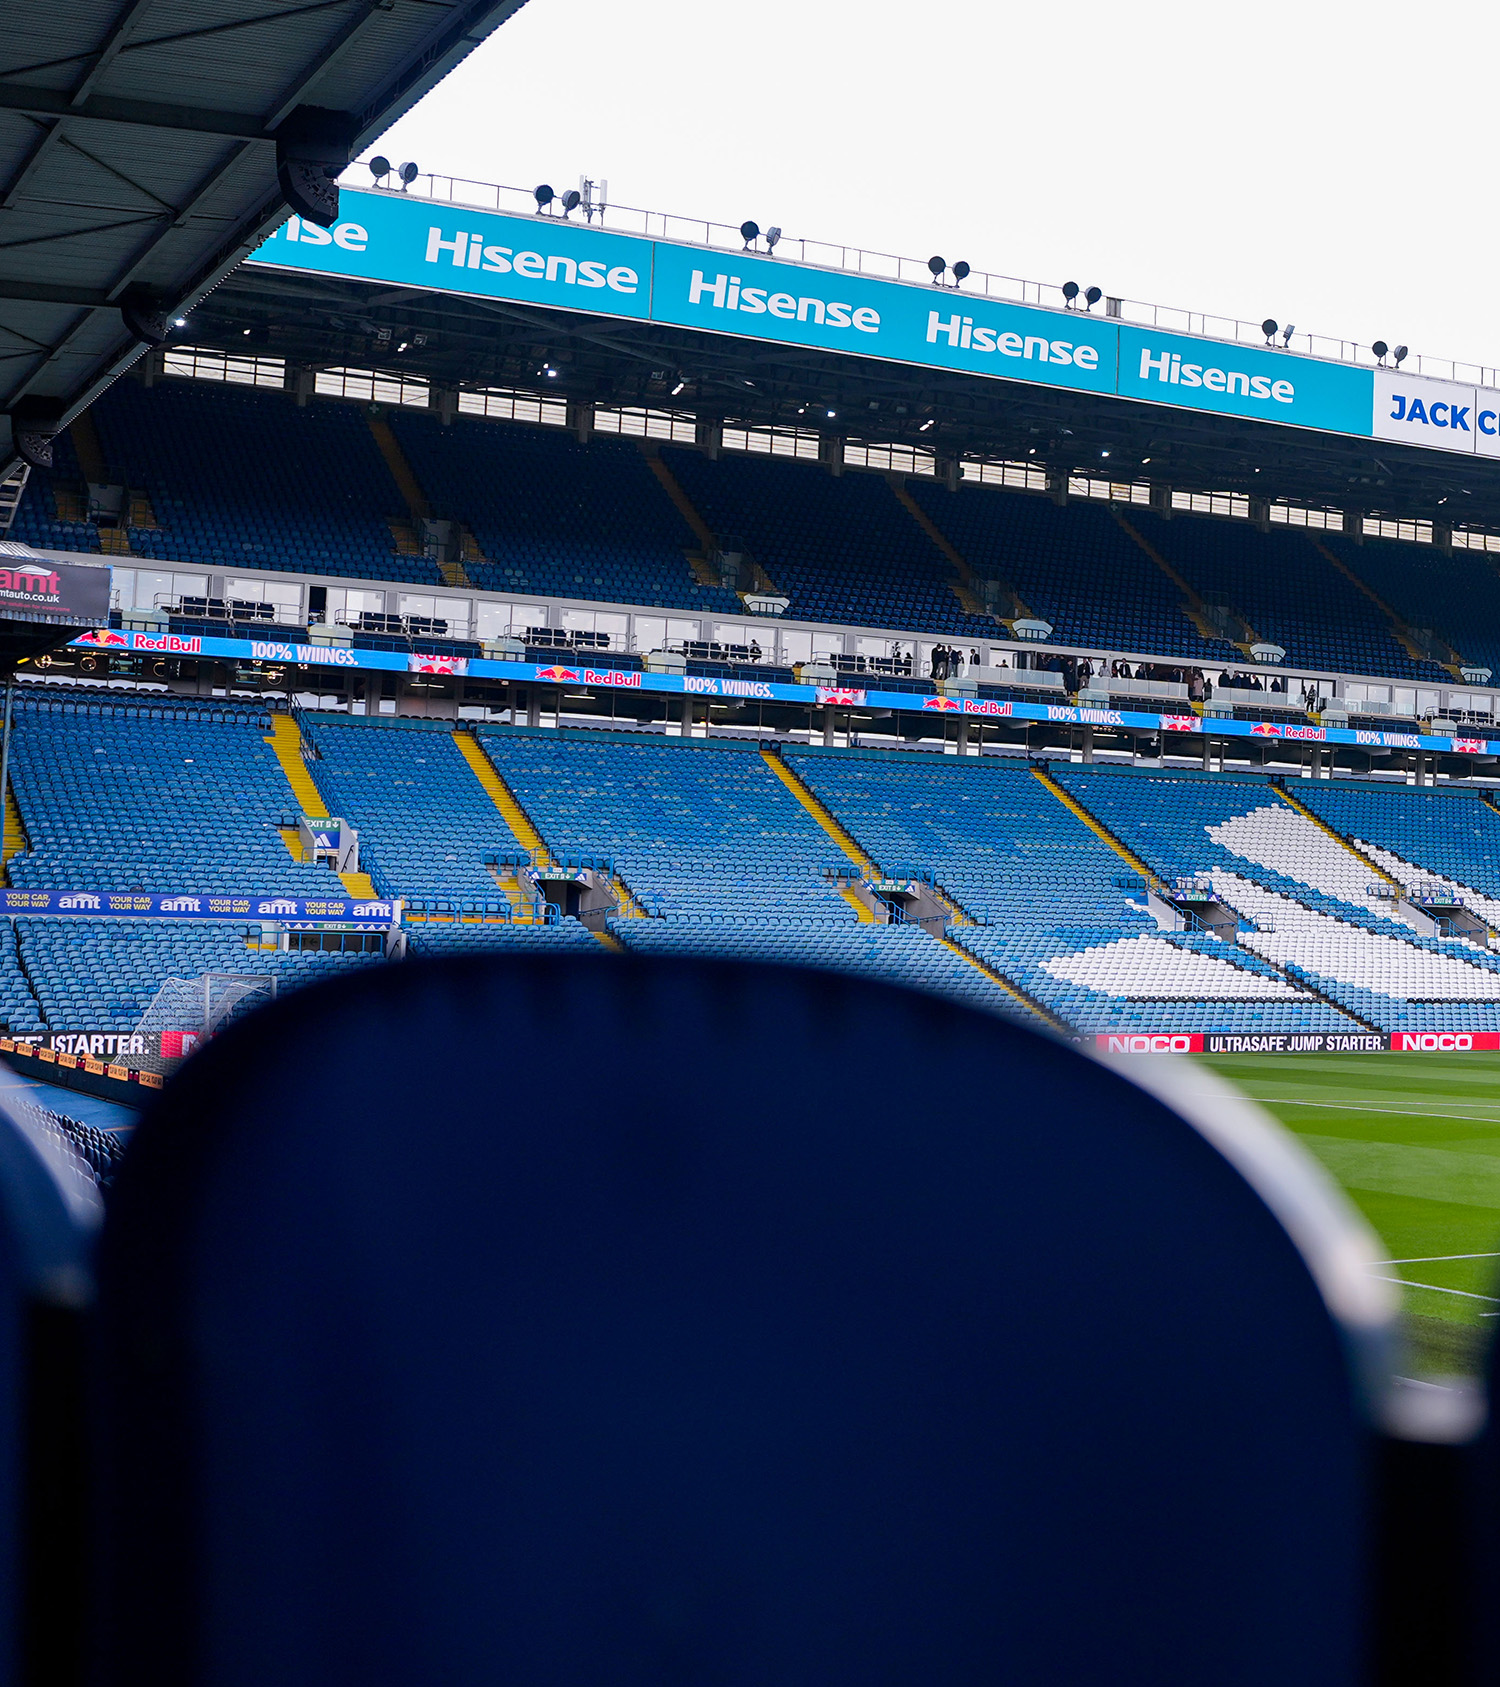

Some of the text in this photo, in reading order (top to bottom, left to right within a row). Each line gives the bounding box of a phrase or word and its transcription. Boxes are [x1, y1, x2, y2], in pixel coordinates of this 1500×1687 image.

[424, 226, 639, 294] Hisense
[688, 270, 881, 333] Hisense
[926, 311, 1099, 370] Hisense
[1139, 349, 1295, 403] Hisense
[1390, 394, 1470, 432] JACK
[0, 570, 61, 594] amt
[251, 641, 359, 666] 100% WIIINGS.
[683, 677, 774, 699] 100% WIIINGS.
[1047, 706, 1124, 725] 100% WIIINGS.
[1356, 731, 1421, 748] 100% WIIINGS.
[305, 820, 324, 828] EXIT
[58, 894, 100, 909] amt
[160, 897, 201, 912] amt
[258, 900, 297, 915] amt
[352, 902, 391, 917] amt
[290, 935, 307, 946] EXT
[1108, 1036, 1190, 1053] NOCO
[1209, 1035, 1384, 1052] ULTRASAFE JUMP STARTER.
[1402, 1034, 1472, 1050] NOCO
